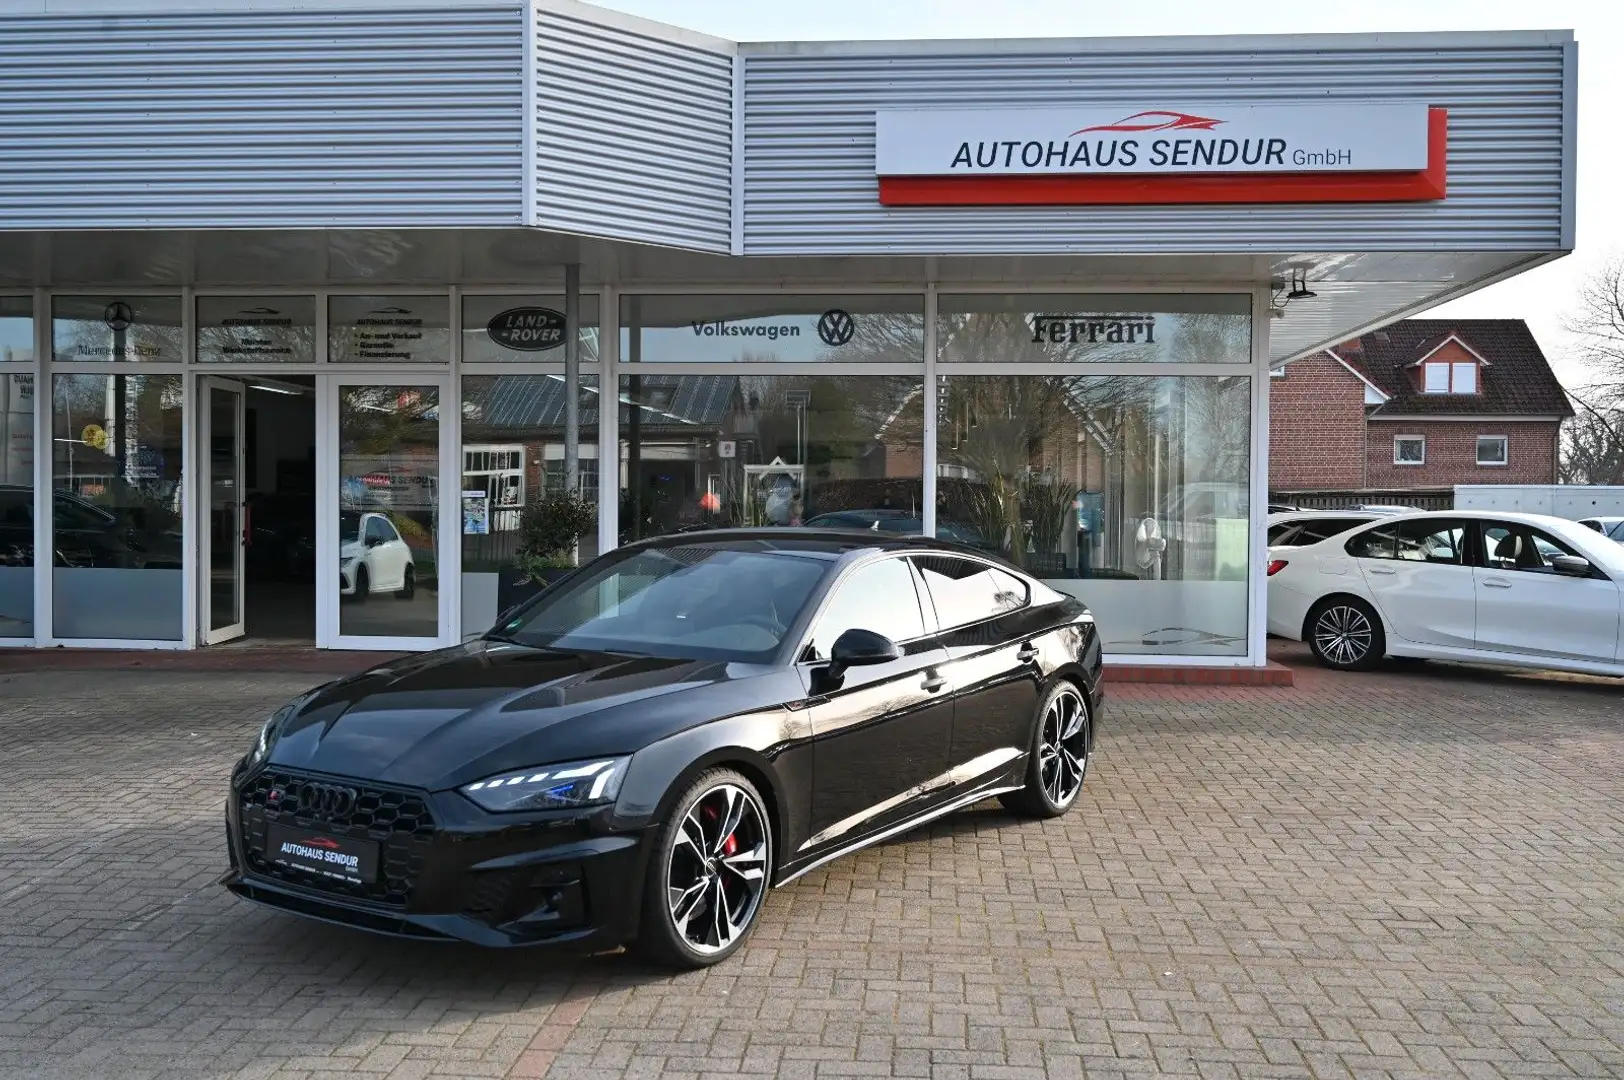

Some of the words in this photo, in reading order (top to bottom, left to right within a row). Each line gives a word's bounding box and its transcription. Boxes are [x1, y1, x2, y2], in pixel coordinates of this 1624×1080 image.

[951, 140, 1138, 168] AUTOHAUS
[1148, 138, 1287, 166] SENDUR
[1292, 148, 1352, 166] GmbH
[692, 320, 800, 340] Volkswagen
[1031, 315, 1155, 343] Ferrari
[280, 842, 323, 861] AUTOHAUS
[324, 850, 359, 867] SENDUR
